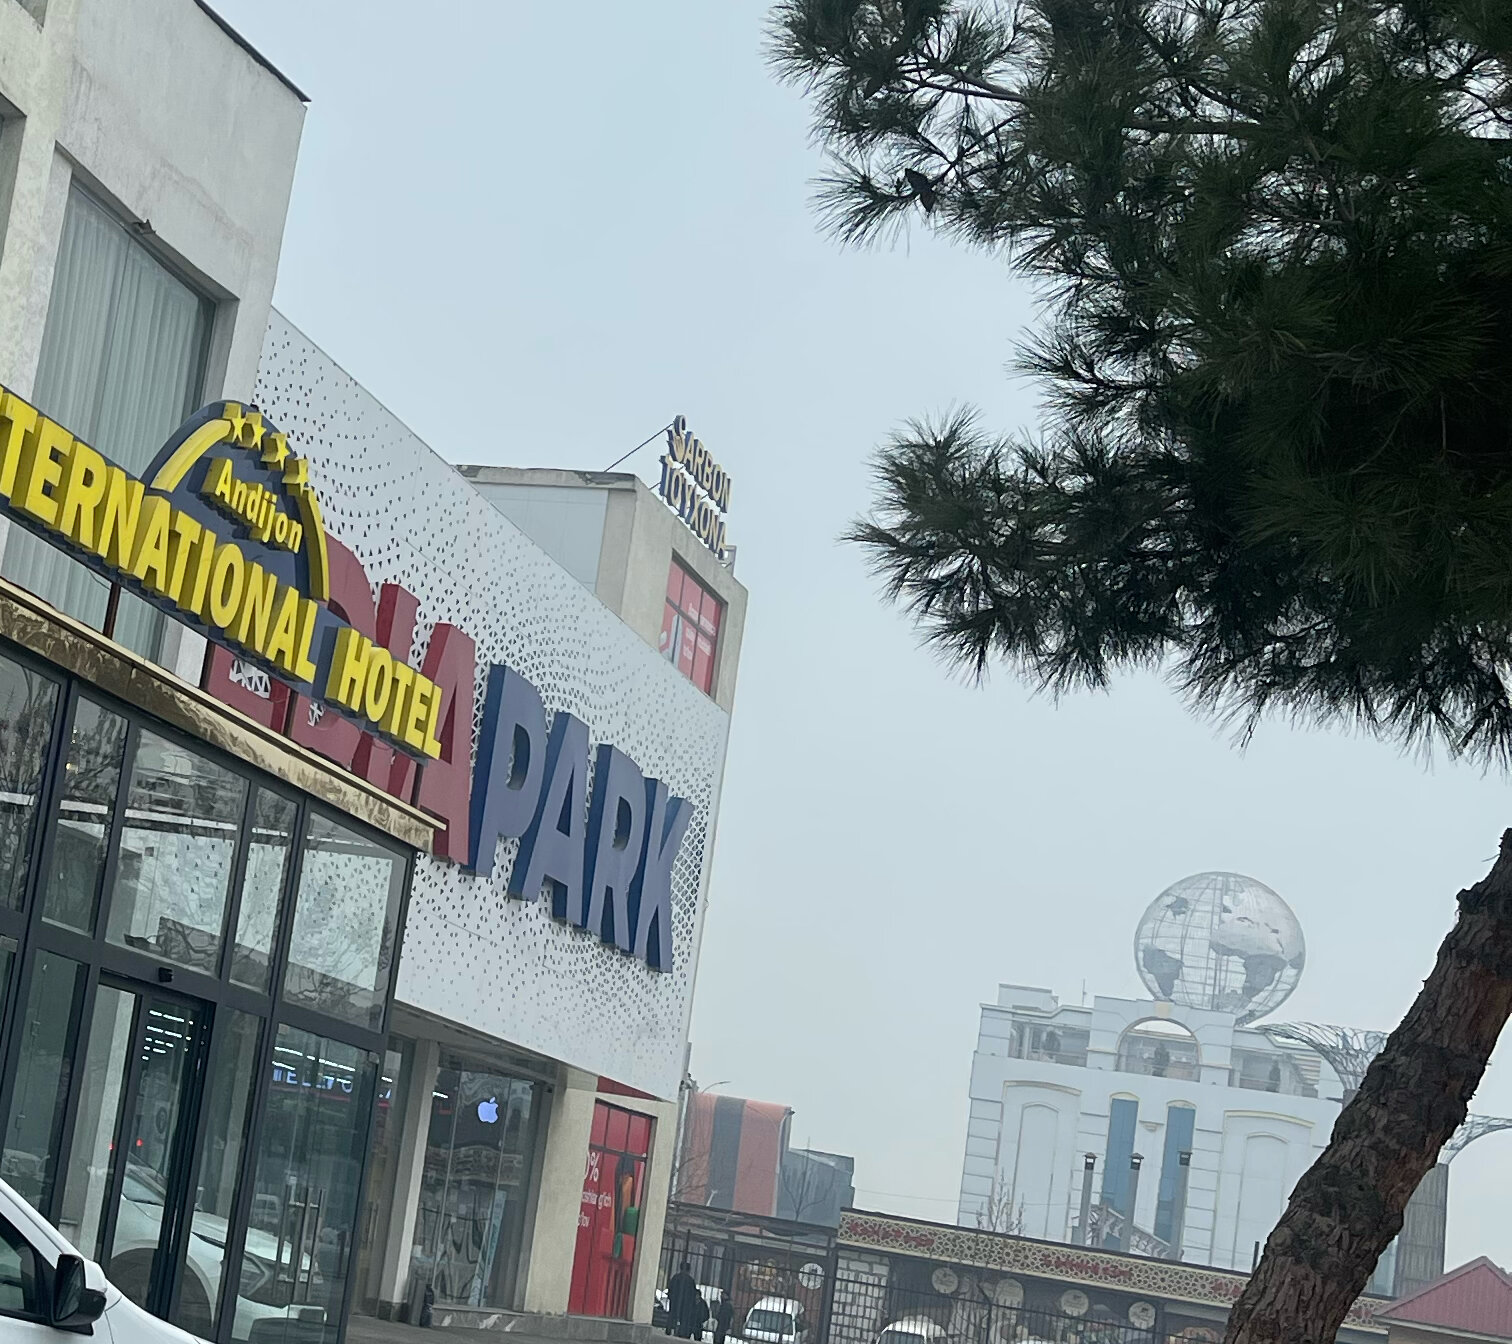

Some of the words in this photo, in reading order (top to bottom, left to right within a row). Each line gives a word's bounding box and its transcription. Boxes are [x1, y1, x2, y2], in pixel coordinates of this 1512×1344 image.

[201, 457, 304, 554] Andijon
[667, 414, 733, 514] SARBON
[324, 626, 443, 762] HOTEL
[464, 663, 694, 974] PARK
